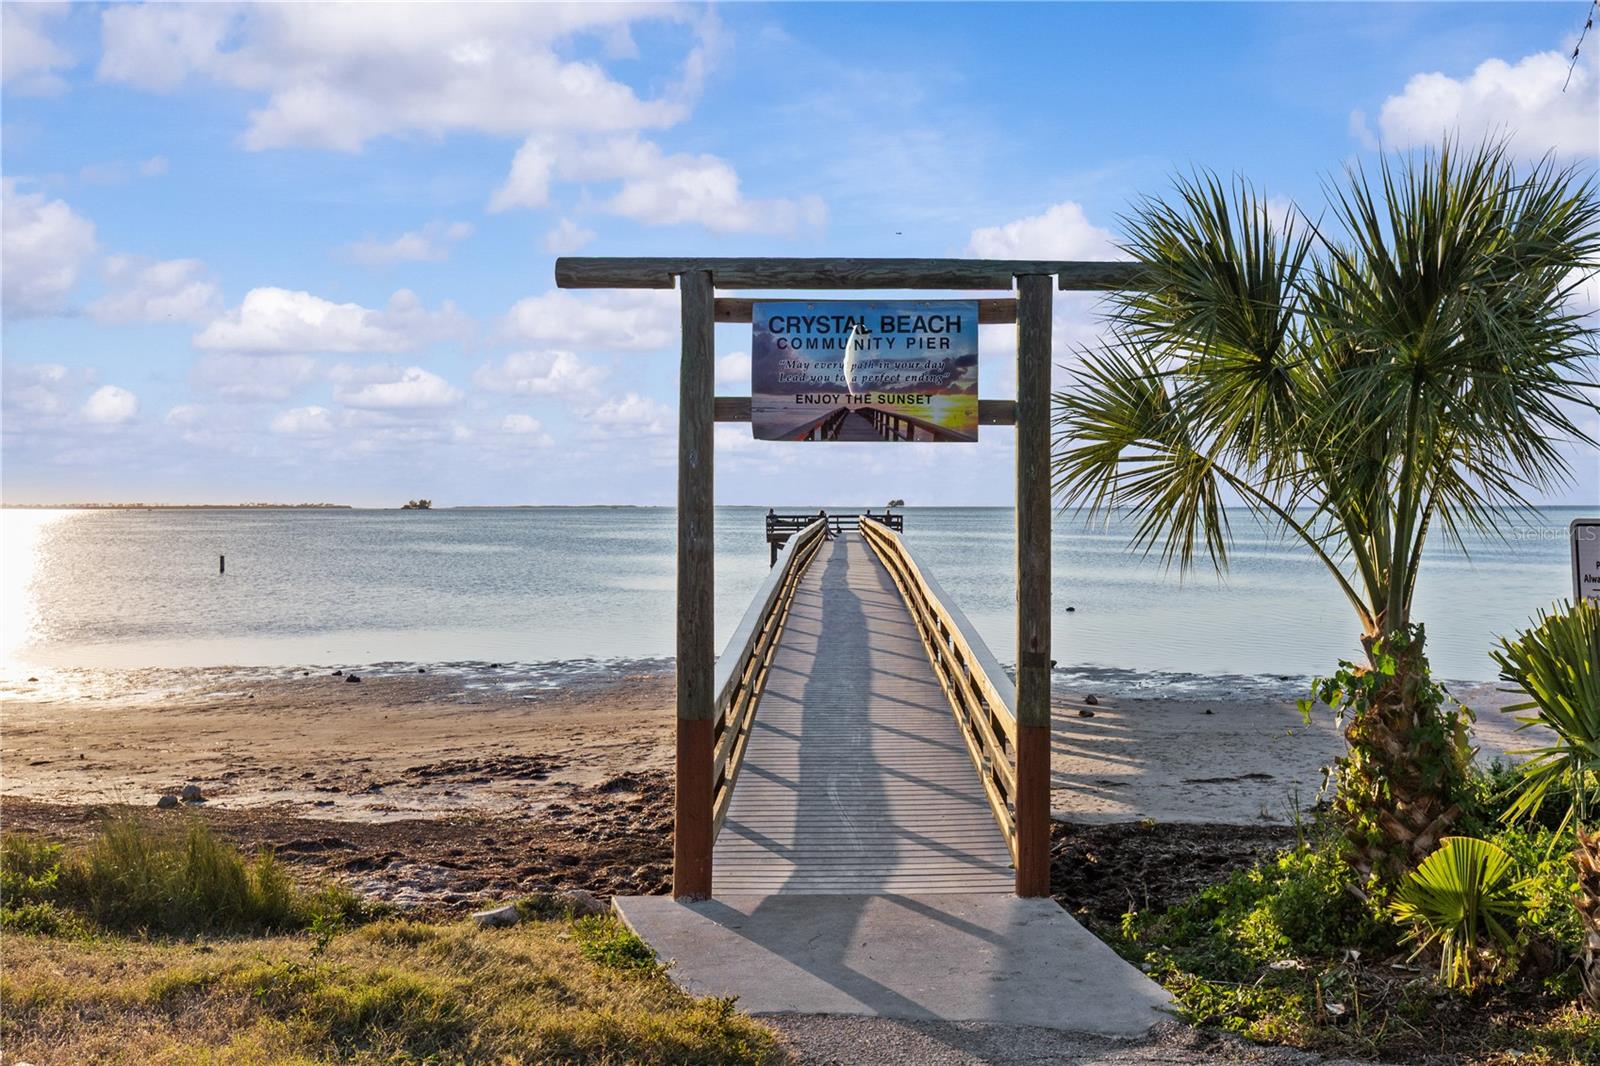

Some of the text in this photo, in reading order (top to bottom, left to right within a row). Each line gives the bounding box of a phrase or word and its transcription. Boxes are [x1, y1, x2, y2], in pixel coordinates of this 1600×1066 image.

[769, 315, 962, 335] CRYSTAL BEACH
[776, 337, 950, 351] COMMUNITY PIER
[814, 362, 845, 374] every
[850, 360, 874, 373] path
[879, 361, 890, 369] in
[894, 362, 921, 373] your
[924, 360, 946, 373] day
[810, 375, 831, 385] you
[835, 374, 846, 382] to
[861, 372, 900, 384] perfect
[795, 394, 933, 405] ENJOY THE SUNSET
